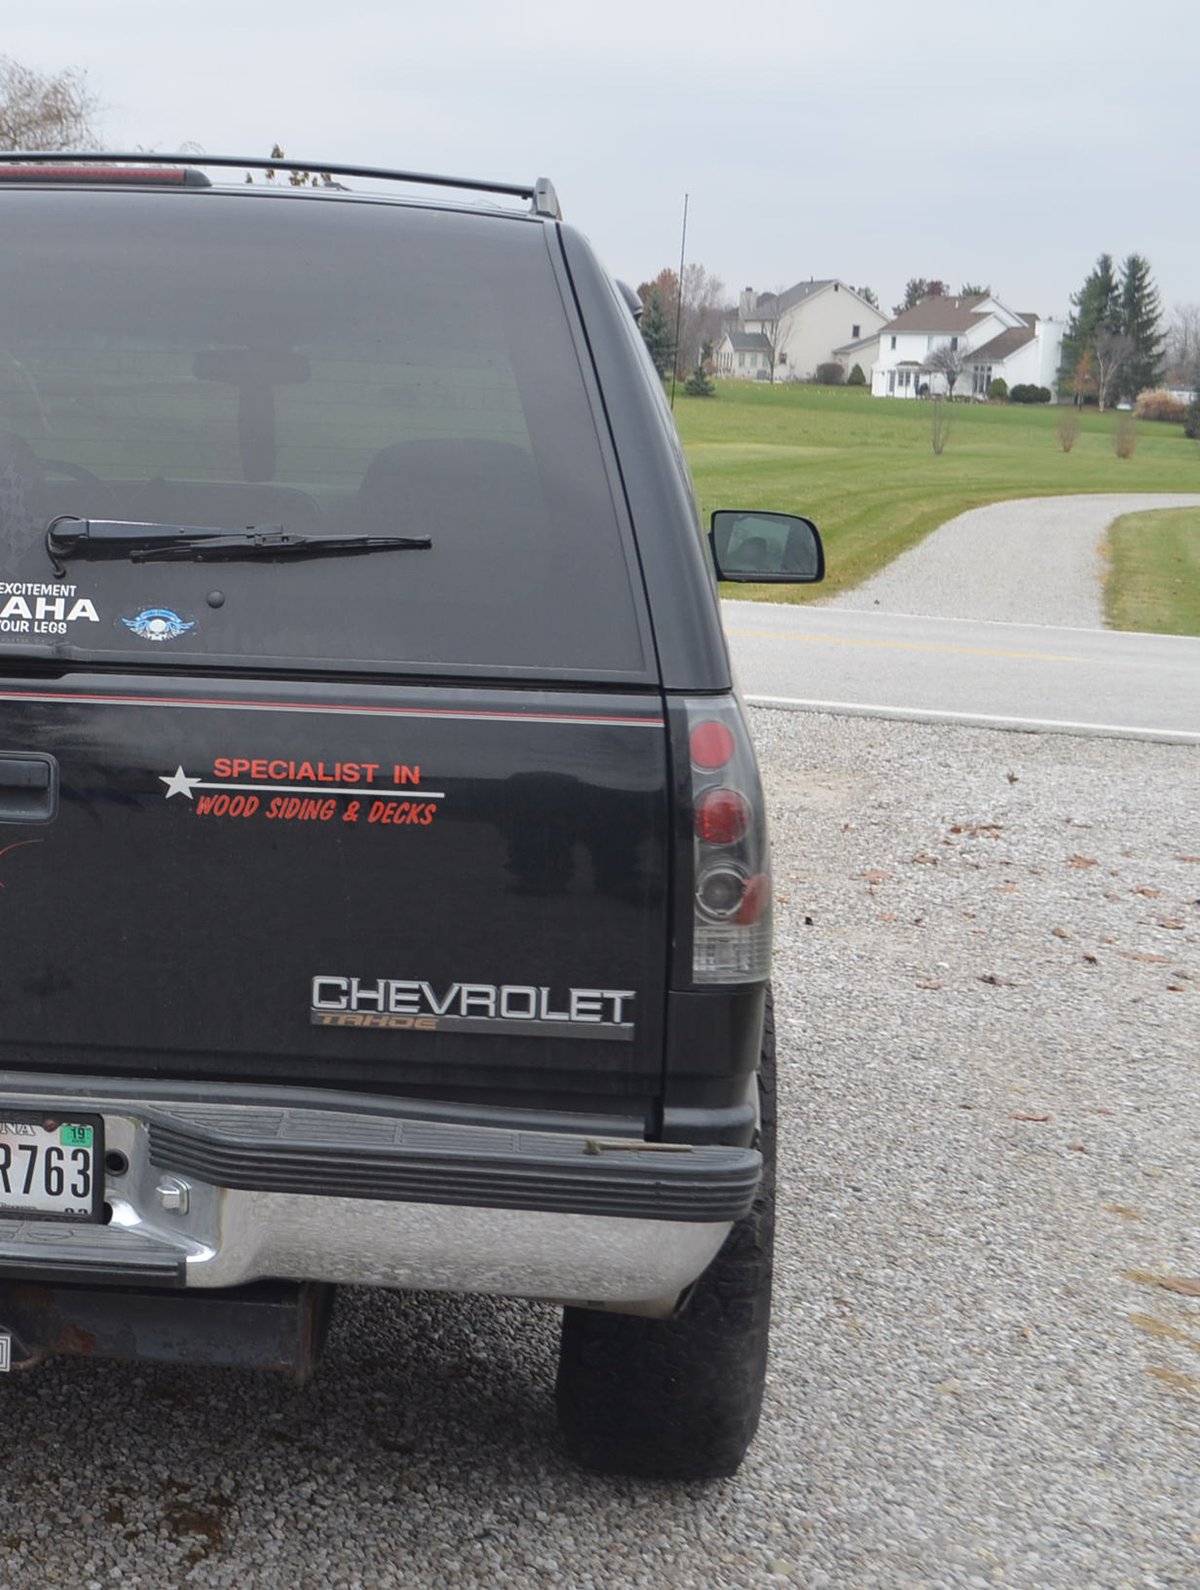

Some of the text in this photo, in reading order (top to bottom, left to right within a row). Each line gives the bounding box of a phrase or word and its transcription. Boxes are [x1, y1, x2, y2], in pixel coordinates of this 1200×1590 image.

[34, 622, 67, 635] LEGS
[213, 758, 420, 784] SPECIALIST IN
[196, 794, 437, 825] WOOD SIDING & DECKS
[312, 975, 636, 1024] CHEVROLET
[317, 1012, 440, 1030] TAHOE
[71, 1127, 85, 1140] 19
